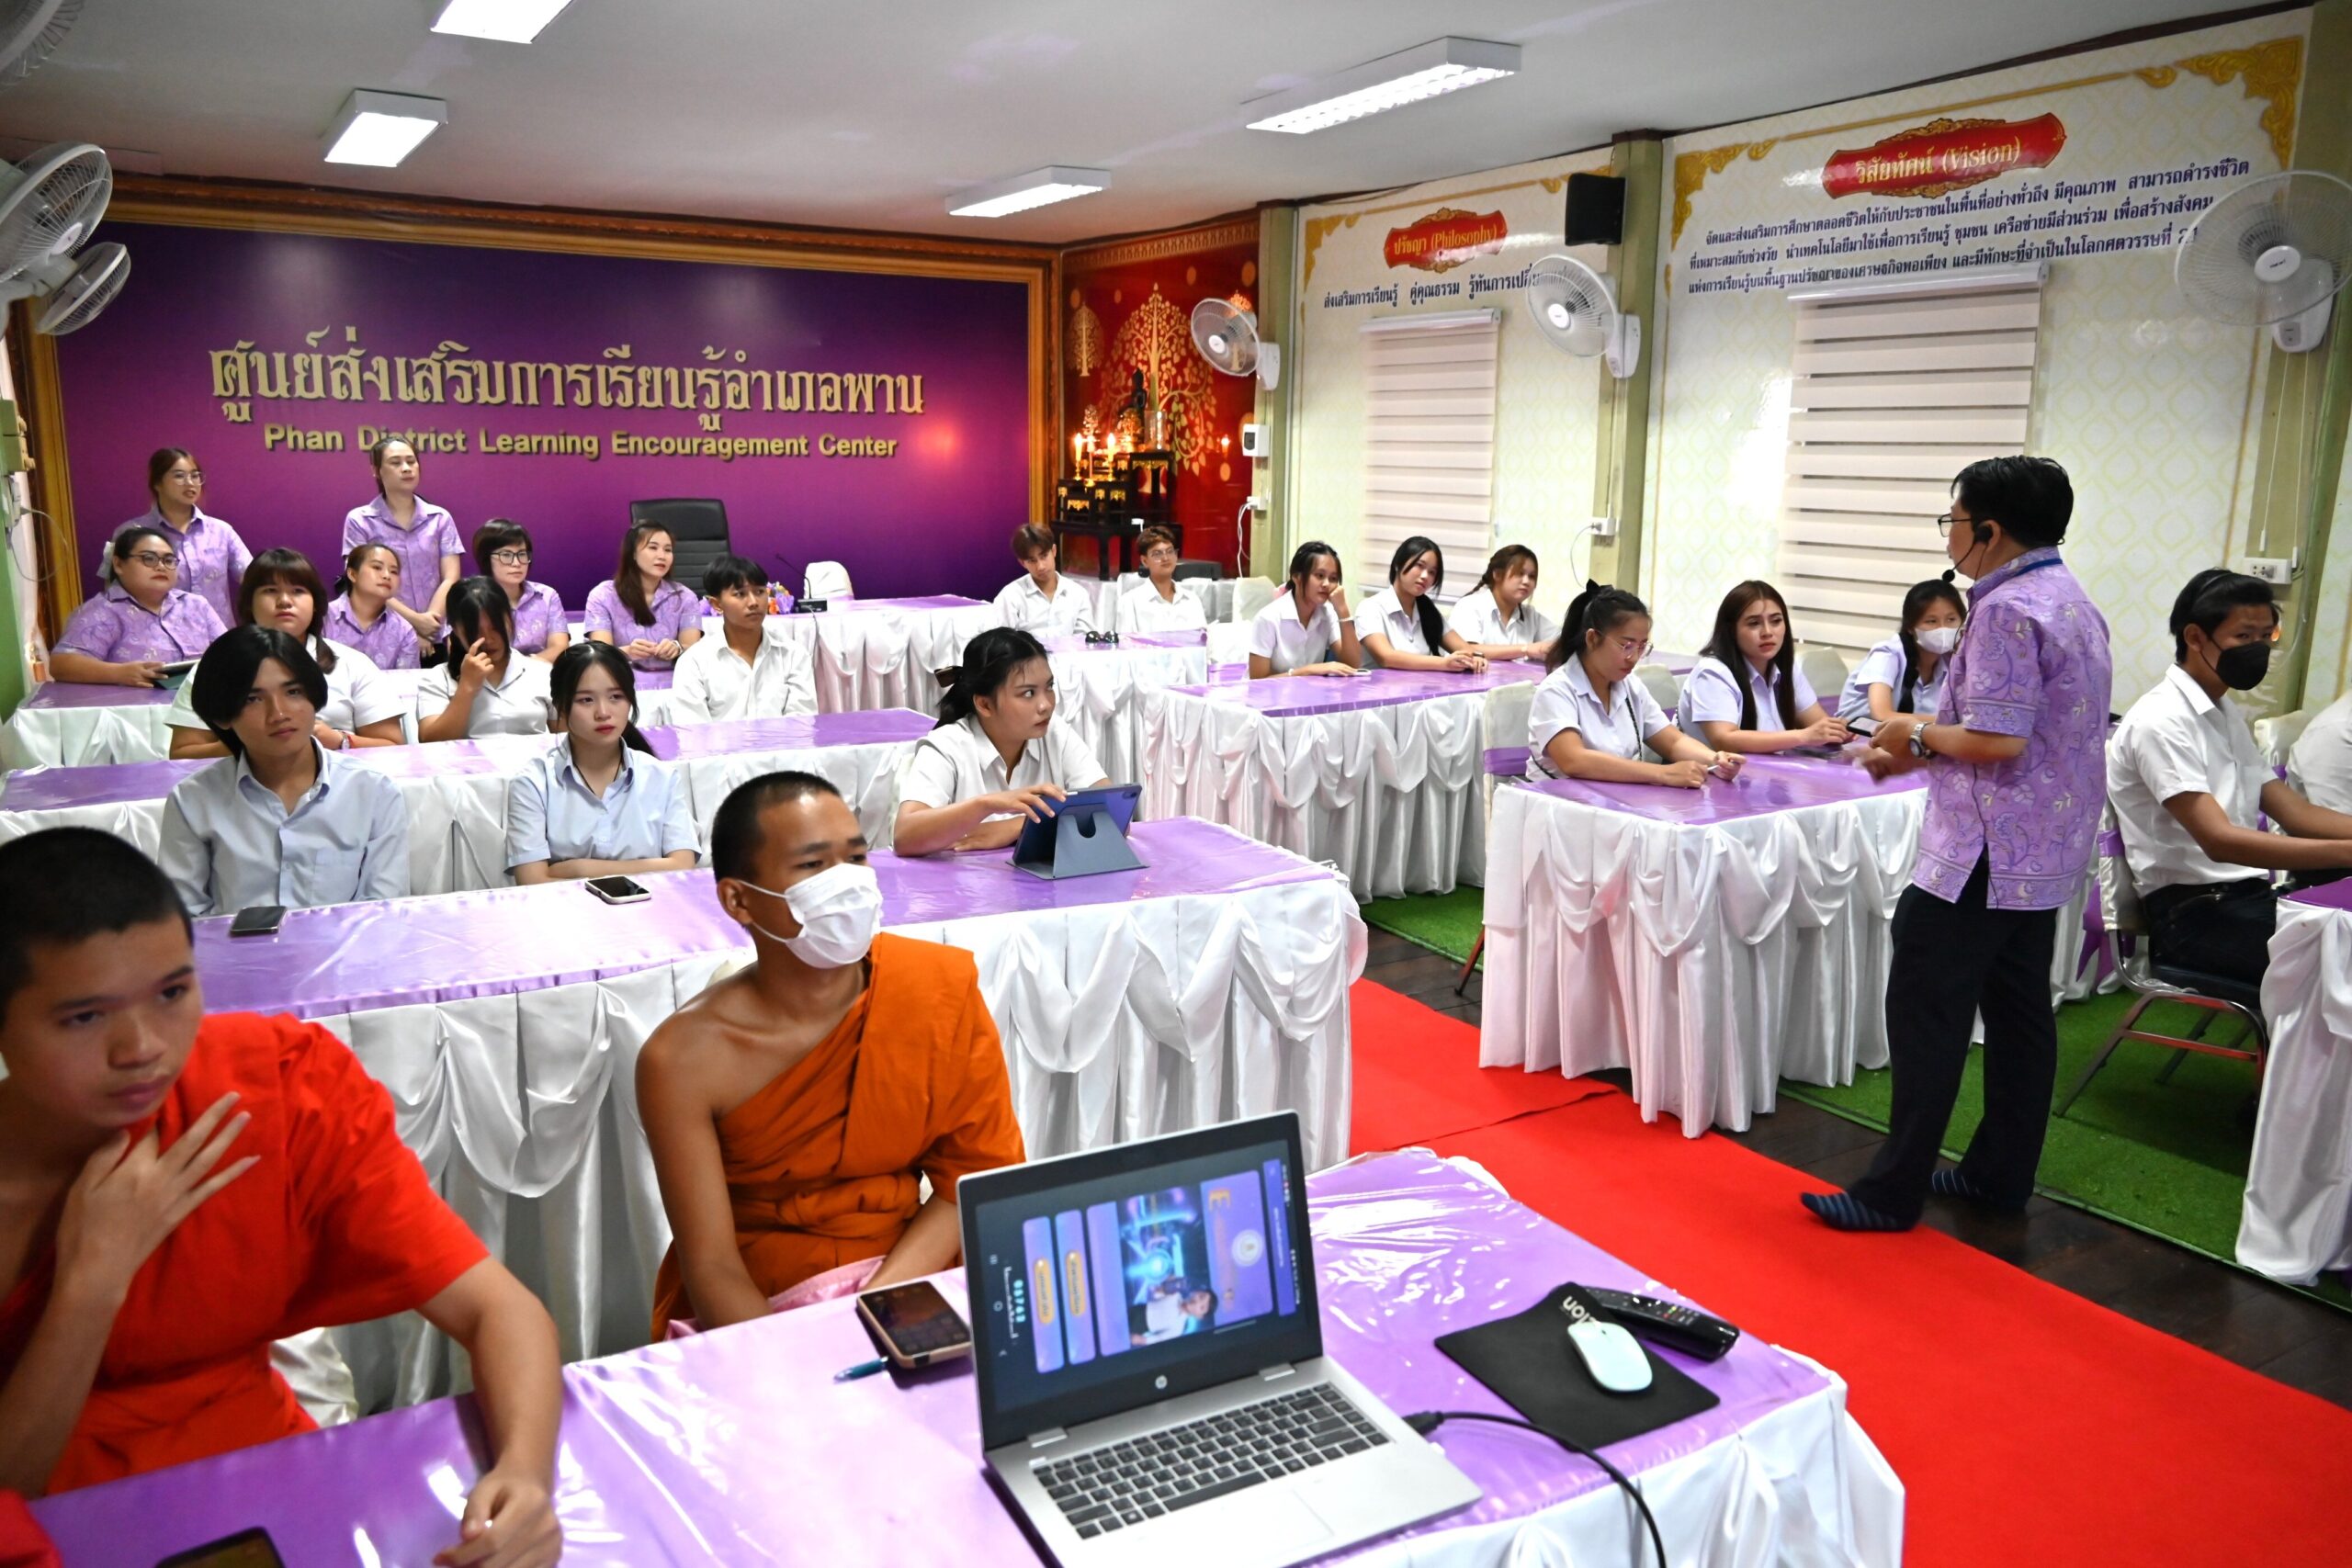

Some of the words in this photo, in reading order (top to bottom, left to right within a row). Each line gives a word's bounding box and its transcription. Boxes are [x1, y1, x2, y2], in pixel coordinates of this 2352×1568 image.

[1856, 147, 1934, 184] วิสัยทัศน์
[1942, 136, 2020, 174] (Vision)
[2054, 179, 2116, 204] มีคุณภาพ
[2128, 157, 2249, 190] สามารถดำรงชีวิต
[1394, 234, 1427, 256] ปรัชญา
[1430, 223, 1498, 252] (Philosophy)
[1690, 246, 1779, 270] ที่เหมาะสมกับช่วงวัย
[1786, 223, 1951, 259] นำเทคโนโลยีมาใช้เพื่อการเรียนรู้
[1955, 224, 1988, 245] ชุมชน
[1994, 206, 2108, 235] เครือข่ายมีส่วนร่วม
[2114, 194, 2214, 221] เพื่อสร้างสังคม
[1324, 283, 1399, 309] ส่งเสริมการเรียนรู้
[1410, 282, 1460, 306] คู่คุณธรรม
[209, 325, 924, 432] ศูนย์ส่งเสริมการเรียนรู้อำเภอพาน
[264, 423, 344, 451] Phan
[357, 424, 468, 453] Ditrict
[480, 428, 599, 458] Learning
[611, 430, 809, 458] Encouragement
[818, 433, 898, 457] Center
